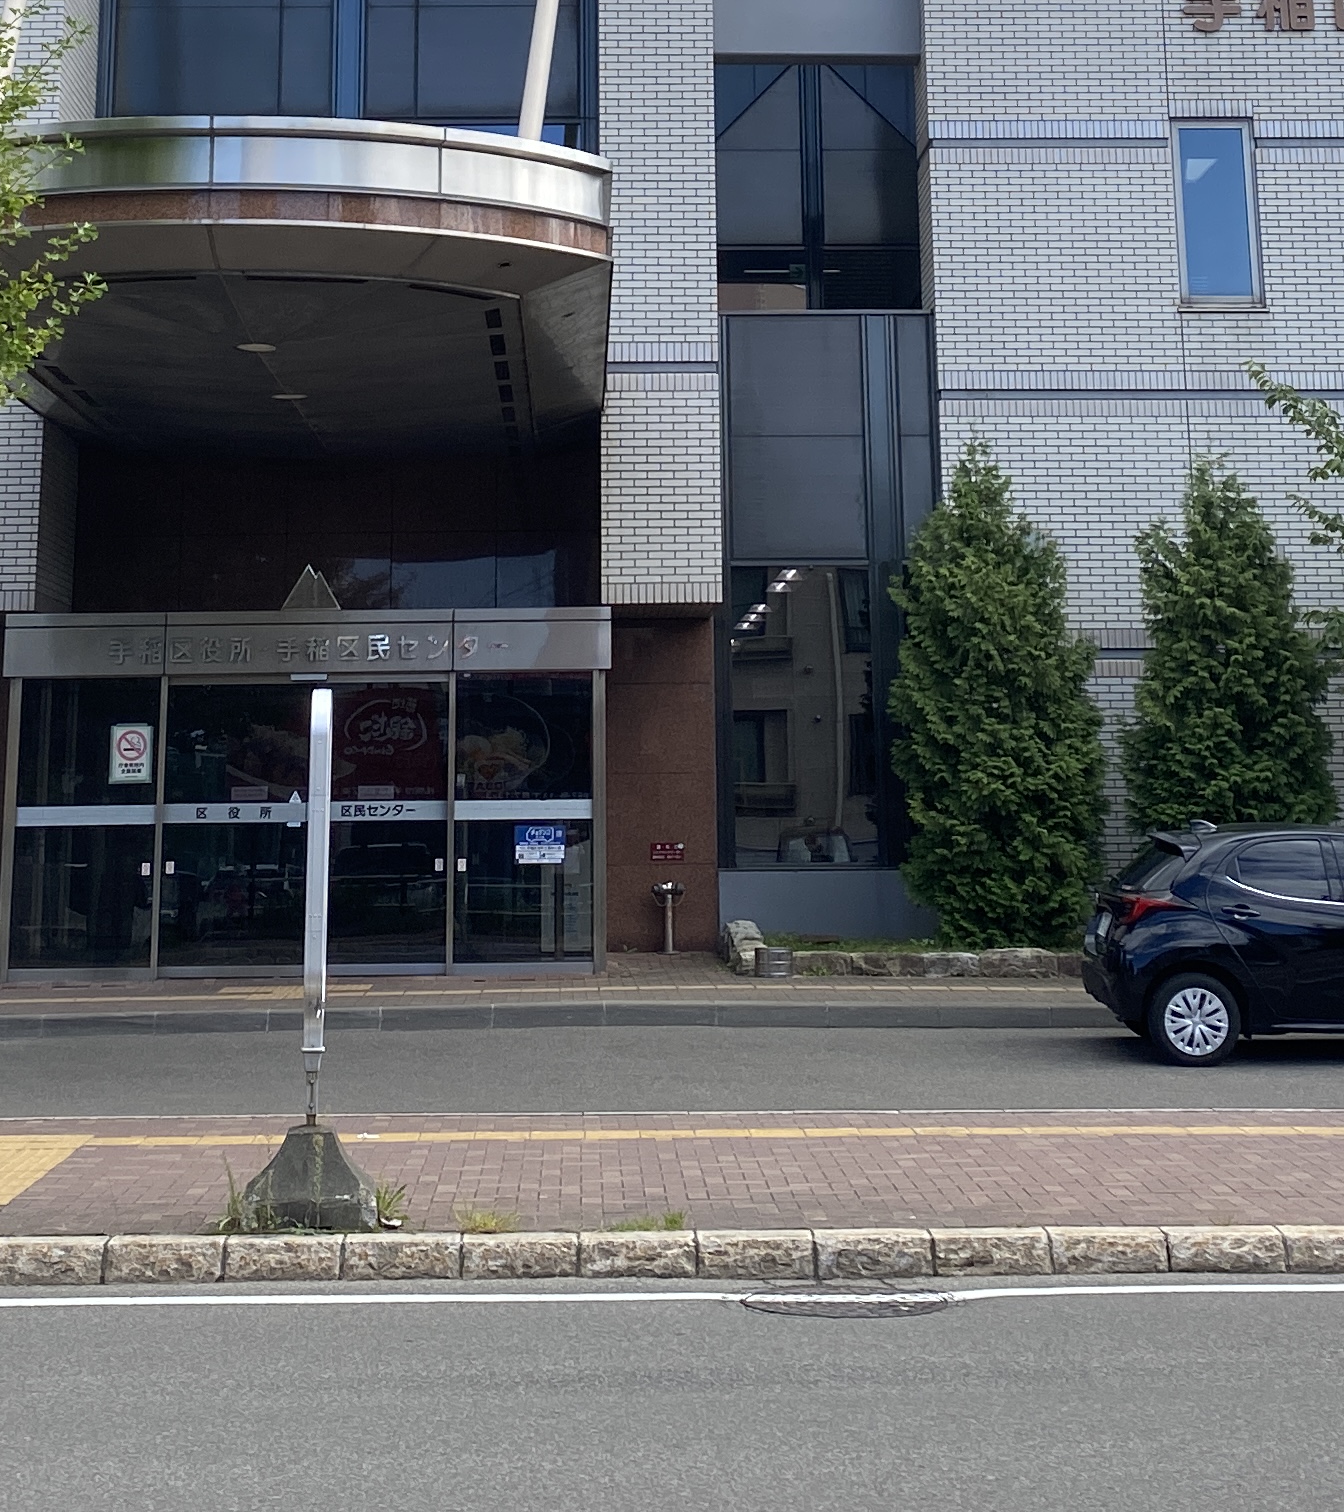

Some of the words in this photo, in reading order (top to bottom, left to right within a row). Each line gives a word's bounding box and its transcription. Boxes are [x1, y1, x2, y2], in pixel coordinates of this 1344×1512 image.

[109, 636, 253, 665] 手稲区役所
[276, 634, 509, 664] 手稲区民センター
[195, 806, 273, 819] 区役所
[340, 804, 417, 818] 区民センター
